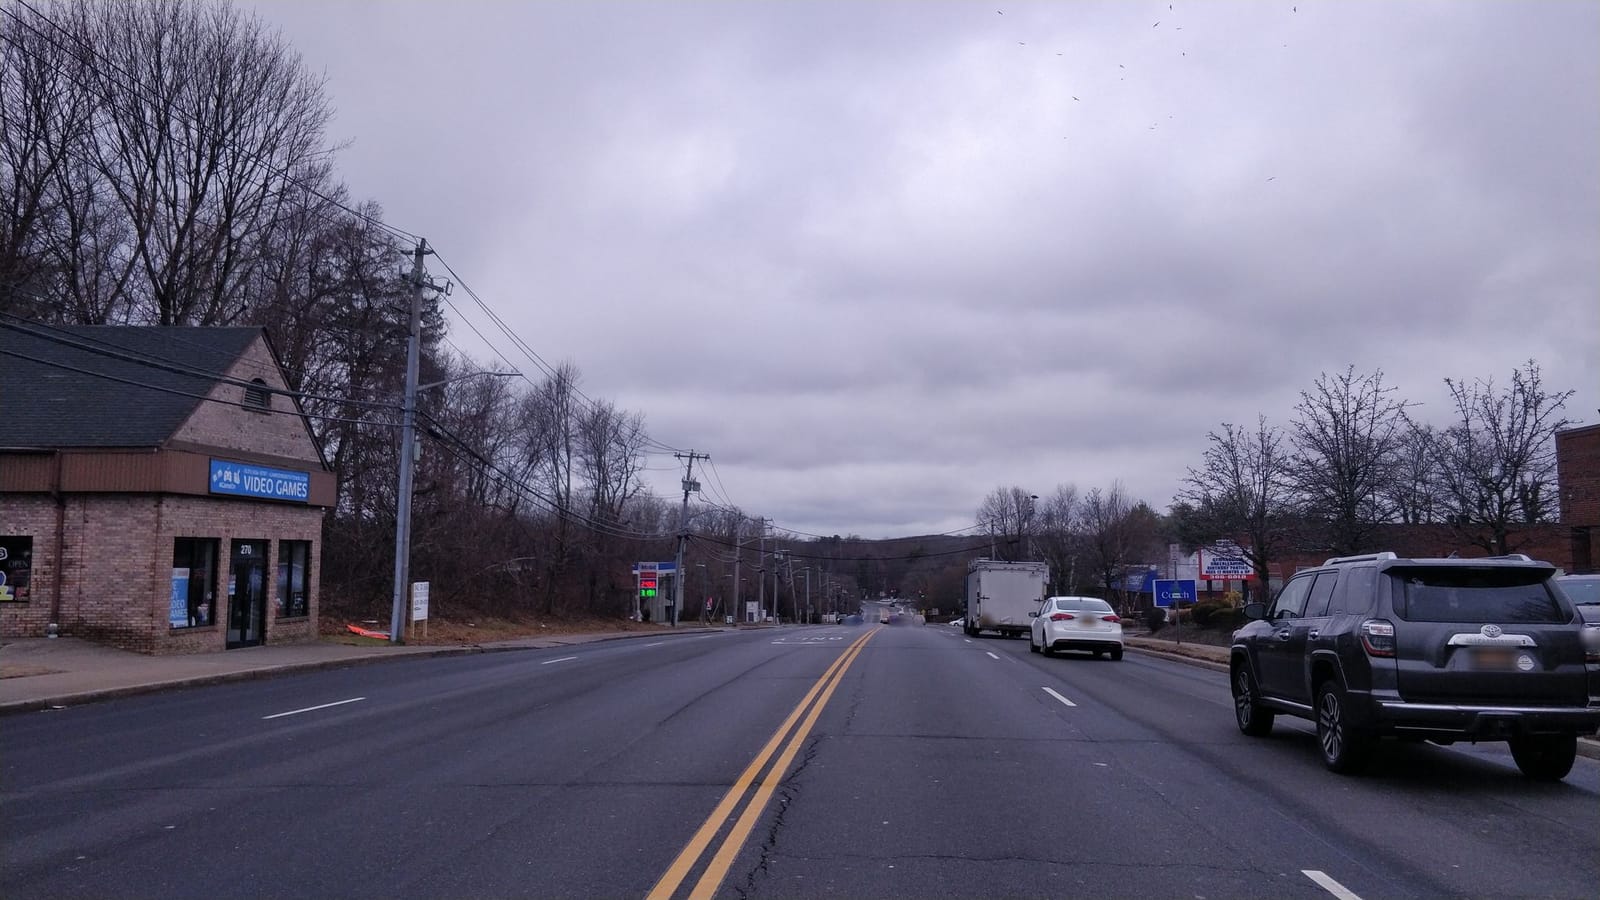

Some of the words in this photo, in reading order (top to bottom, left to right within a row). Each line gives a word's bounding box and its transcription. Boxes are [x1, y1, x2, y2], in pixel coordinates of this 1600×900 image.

[244, 475, 274, 494] VIDEO
[276, 480, 308, 498] GAMES
[241, 545, 251, 554] 270
